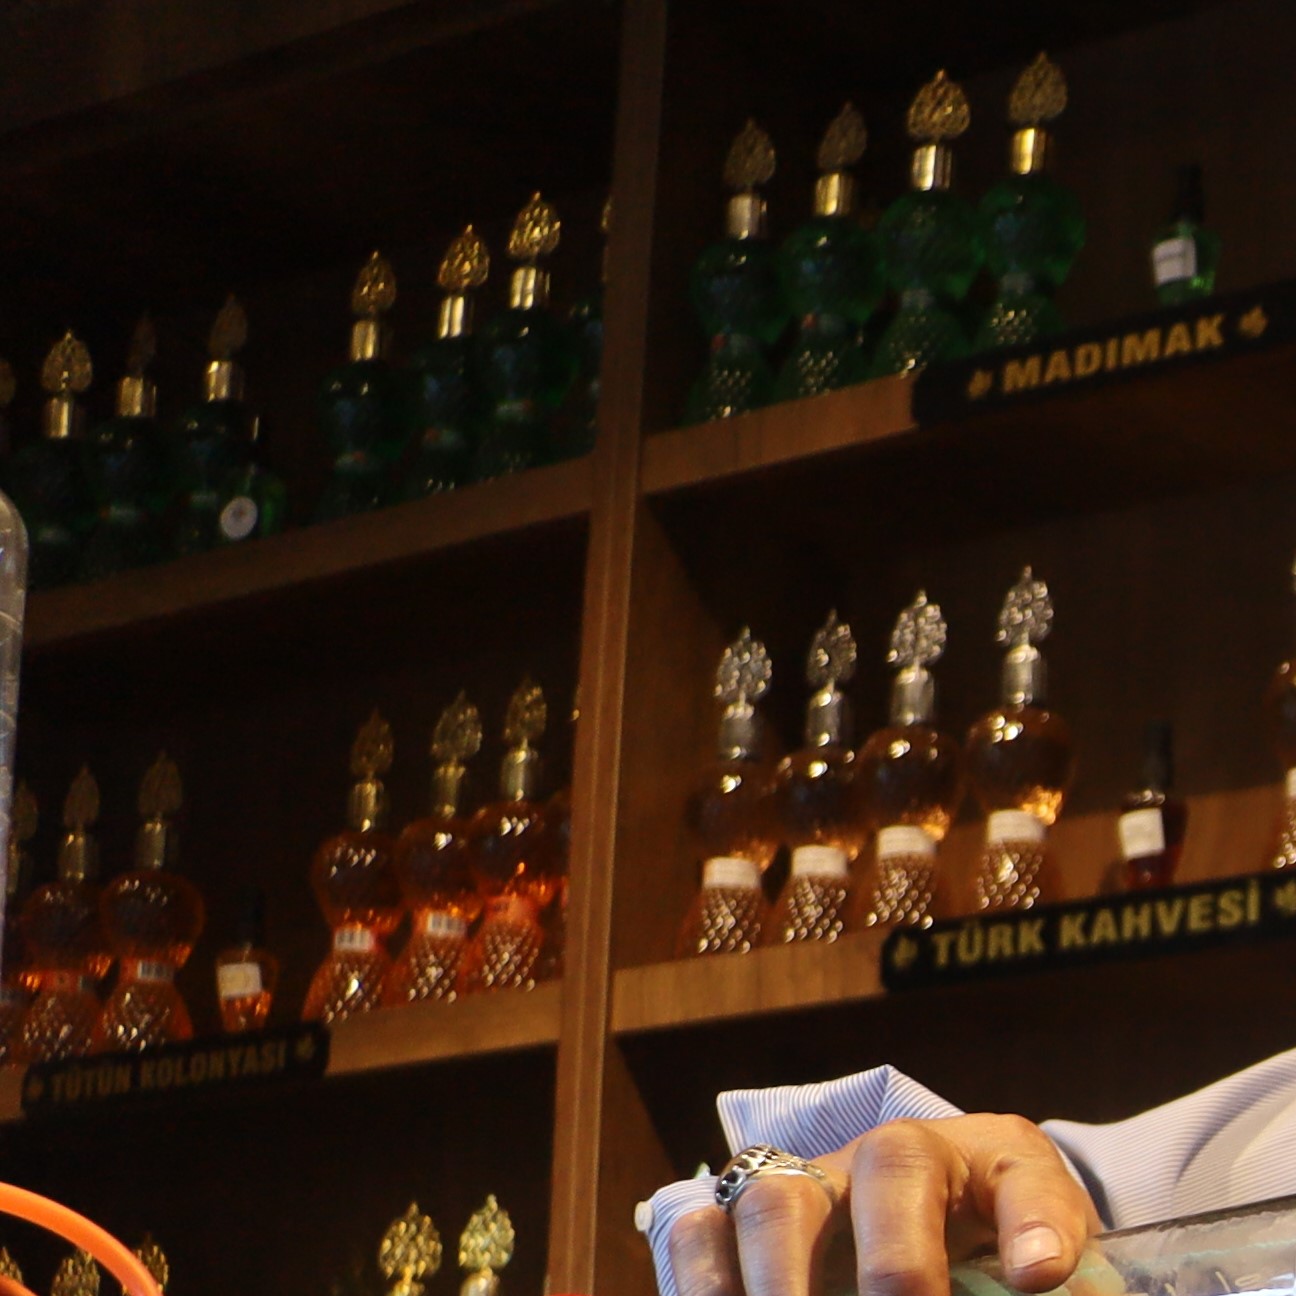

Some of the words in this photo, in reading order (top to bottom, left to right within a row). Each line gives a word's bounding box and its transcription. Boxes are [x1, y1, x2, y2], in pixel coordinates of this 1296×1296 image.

[1002, 312, 1225, 394] MADIMAK
[931, 916, 1046, 970] TÜRK
[1058, 876, 1262, 951] KAHVESİ
